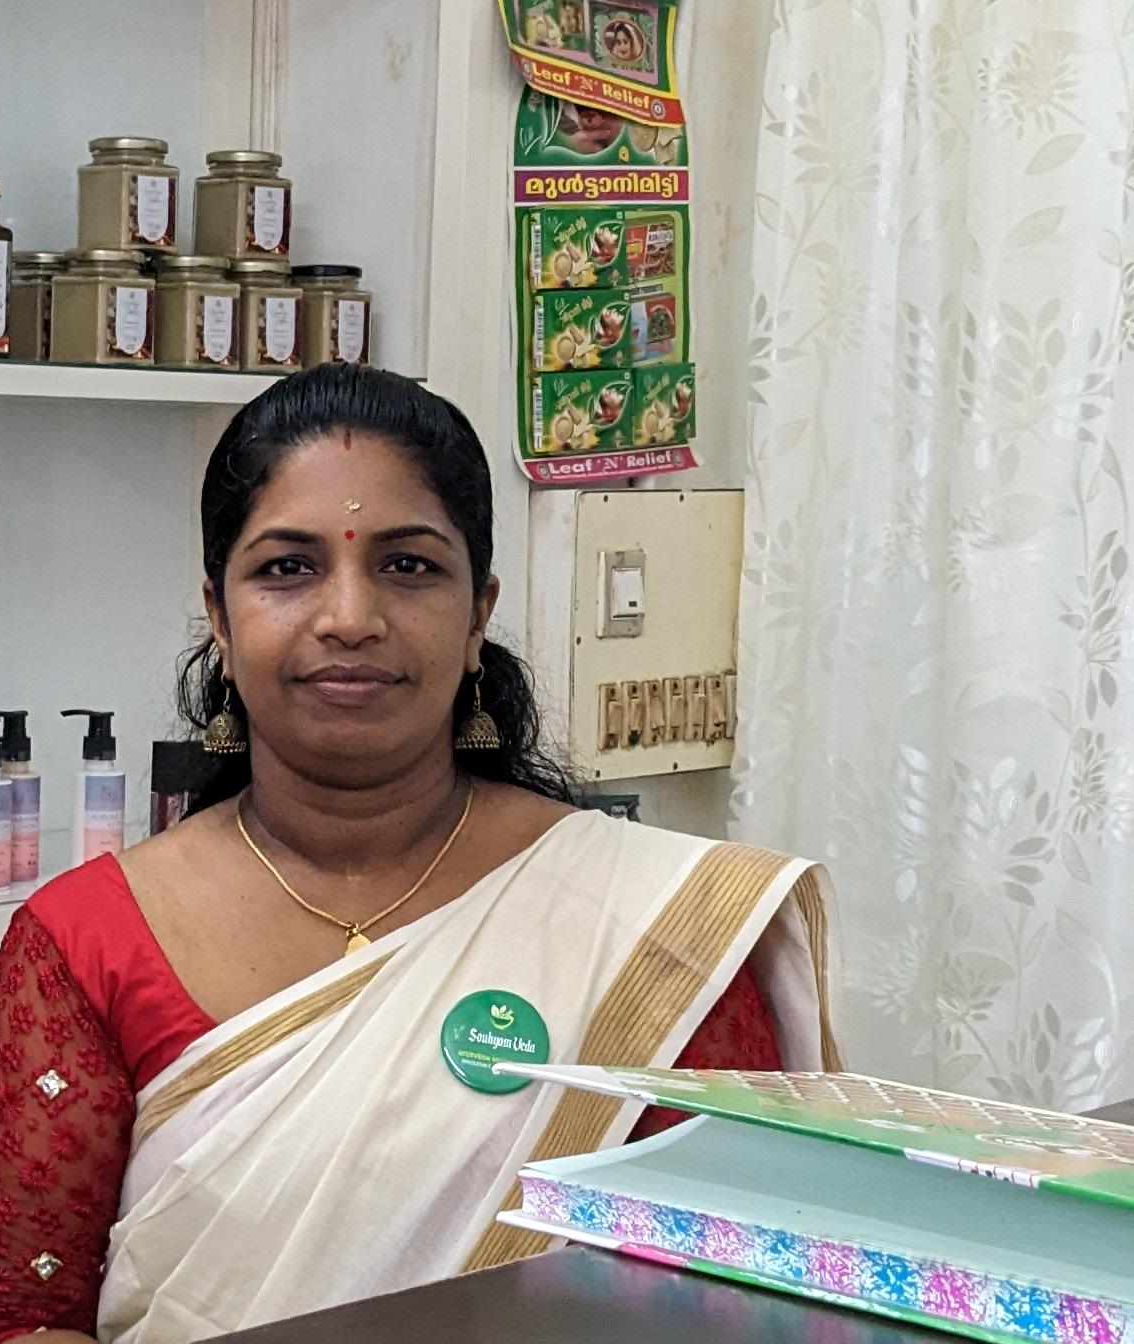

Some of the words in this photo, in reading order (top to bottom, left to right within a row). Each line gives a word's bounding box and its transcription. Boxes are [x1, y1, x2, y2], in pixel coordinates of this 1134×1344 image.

[531, 62, 571, 87] Leaf
[602, 83, 650, 110] Relief
[525, 172, 679, 199] മുൾട്ടാനിമിട്ടി
[548, 457, 593, 475] Leaf
[626, 449, 673, 468] Relief
[513, 1036, 536, 1053] Veda
